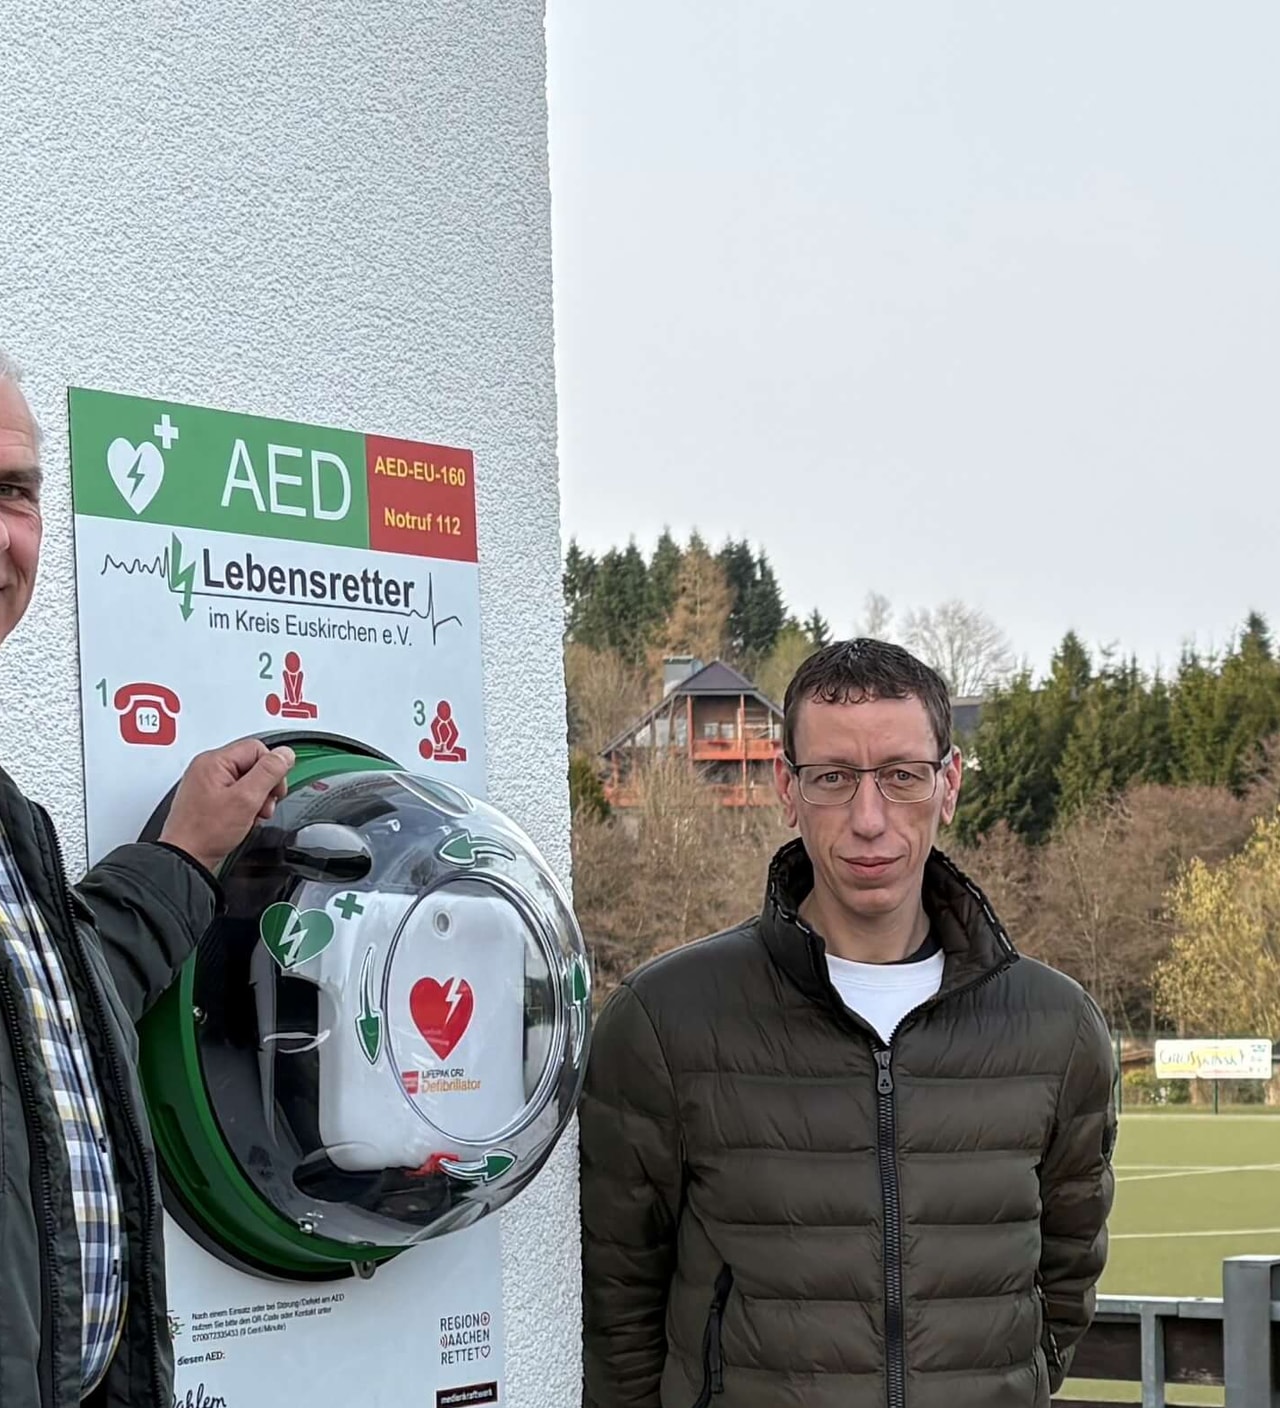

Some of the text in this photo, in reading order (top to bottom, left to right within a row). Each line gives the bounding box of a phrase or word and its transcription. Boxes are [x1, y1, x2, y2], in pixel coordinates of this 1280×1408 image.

[221, 438, 352, 521] AED
[374, 456, 466, 487] AED-EU-160
[384, 507, 461, 535] Notruf 112
[203, 548, 415, 608] Lebensretter
[209, 607, 413, 646] im Kreis Euskirchen e.V.
[258, 652, 273, 680] 2
[95, 678, 108, 707] 1
[138, 713, 158, 727] 112
[413, 700, 426, 726] 3
[421, 1077, 481, 1093] Defibrillator
[440, 1313, 480, 1332] REGION
[448, 1329, 490, 1347] AACHEN
[205, 1351, 226, 1362] AED:
[441, 1346, 480, 1365] RETTET
